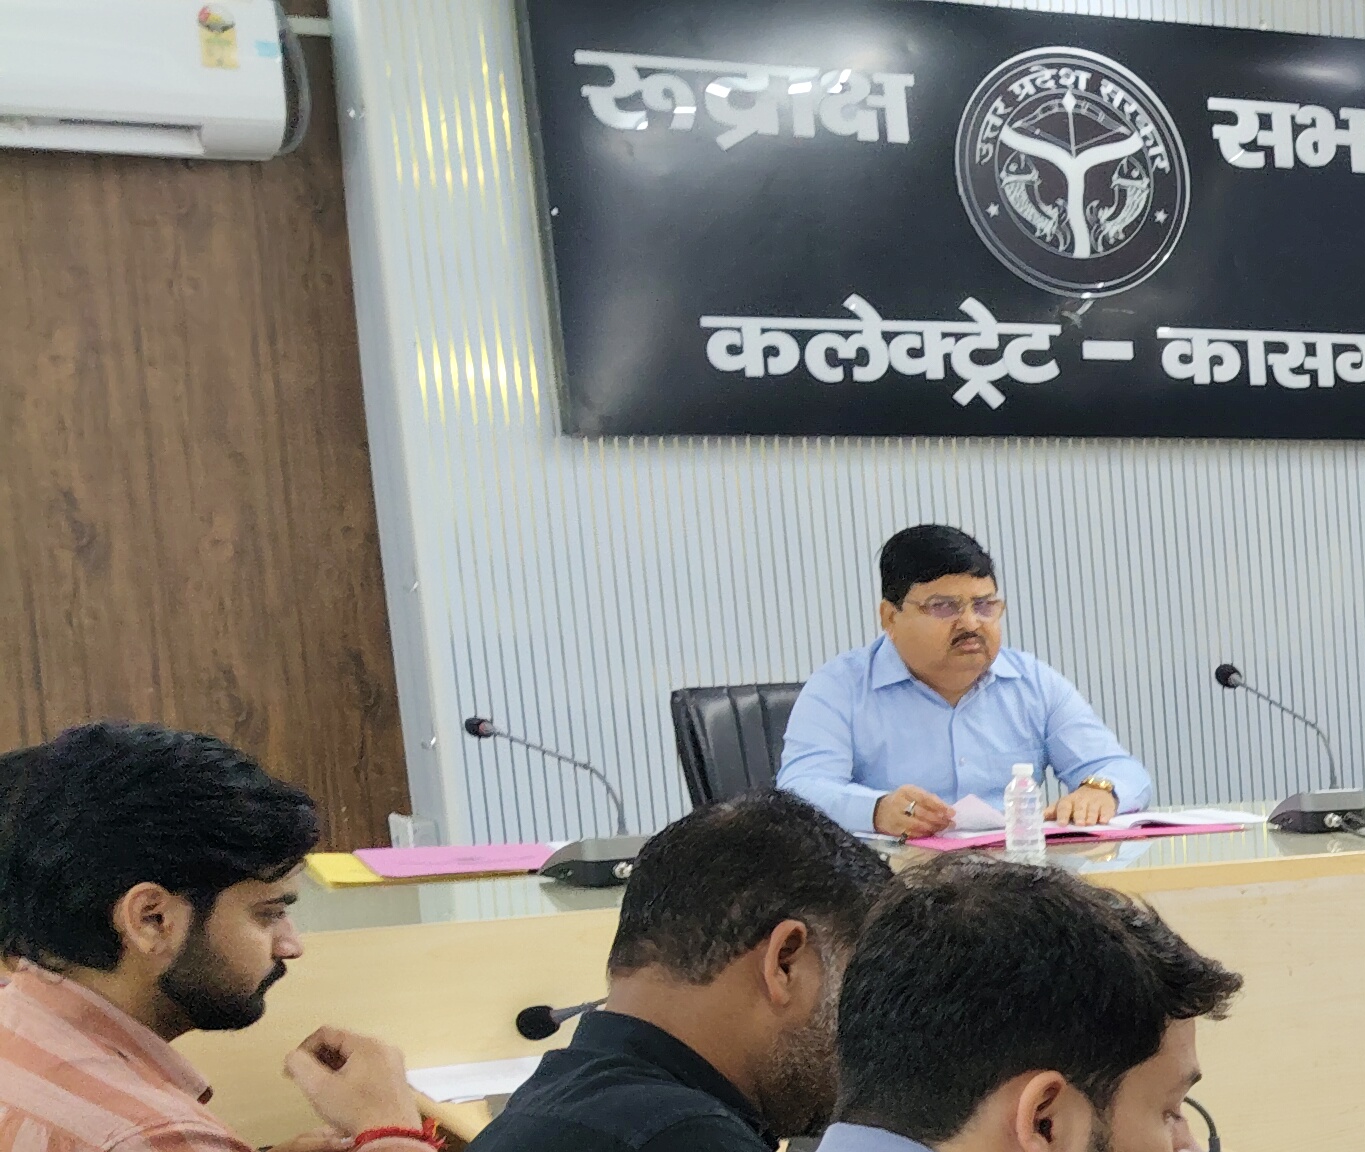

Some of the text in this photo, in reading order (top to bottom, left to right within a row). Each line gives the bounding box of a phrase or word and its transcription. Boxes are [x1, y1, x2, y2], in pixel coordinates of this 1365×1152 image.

[976, 65, 1170, 174] उत्तर प्रदेश सरकार
[700, 293, 1061, 410] कलेक्ट्रेट
